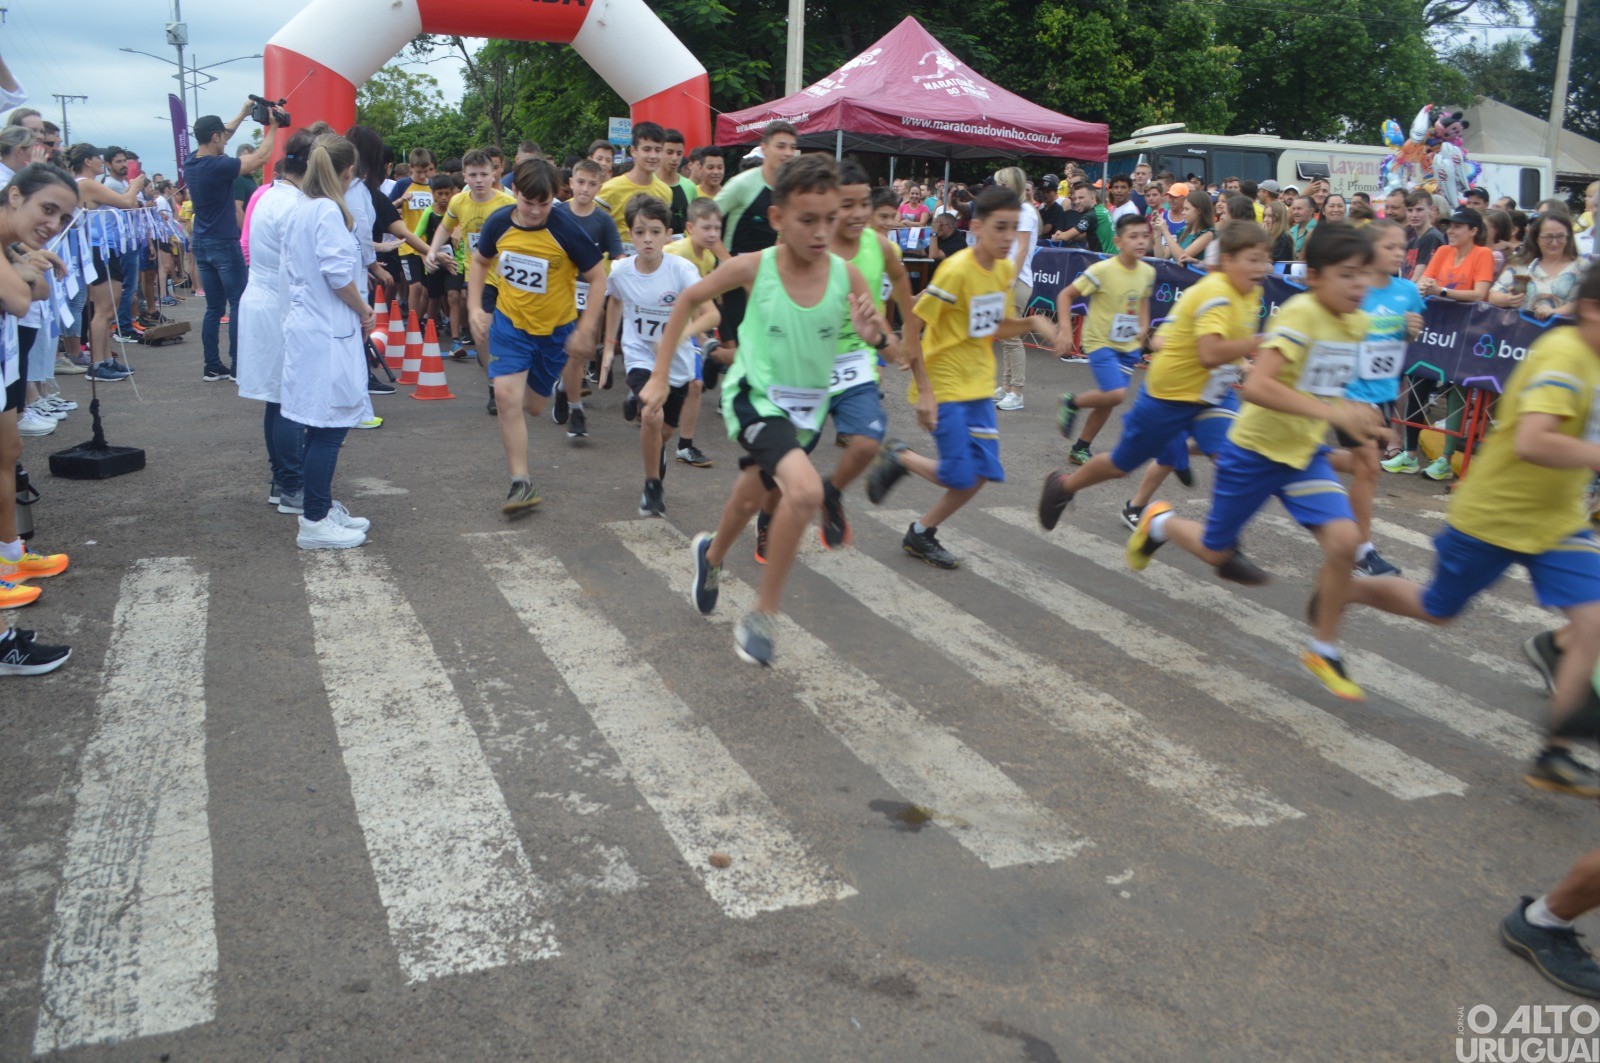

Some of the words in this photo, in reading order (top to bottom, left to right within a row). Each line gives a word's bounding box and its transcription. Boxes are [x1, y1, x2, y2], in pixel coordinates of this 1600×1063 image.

[922, 79, 976, 91] MARATONA
[945, 87, 960, 96] DO
[960, 86, 989, 99] VINHO
[901, 116, 1062, 146] www.maratonadovinho.com.br
[411, 198, 432, 208] 163
[503, 265, 543, 289] 222
